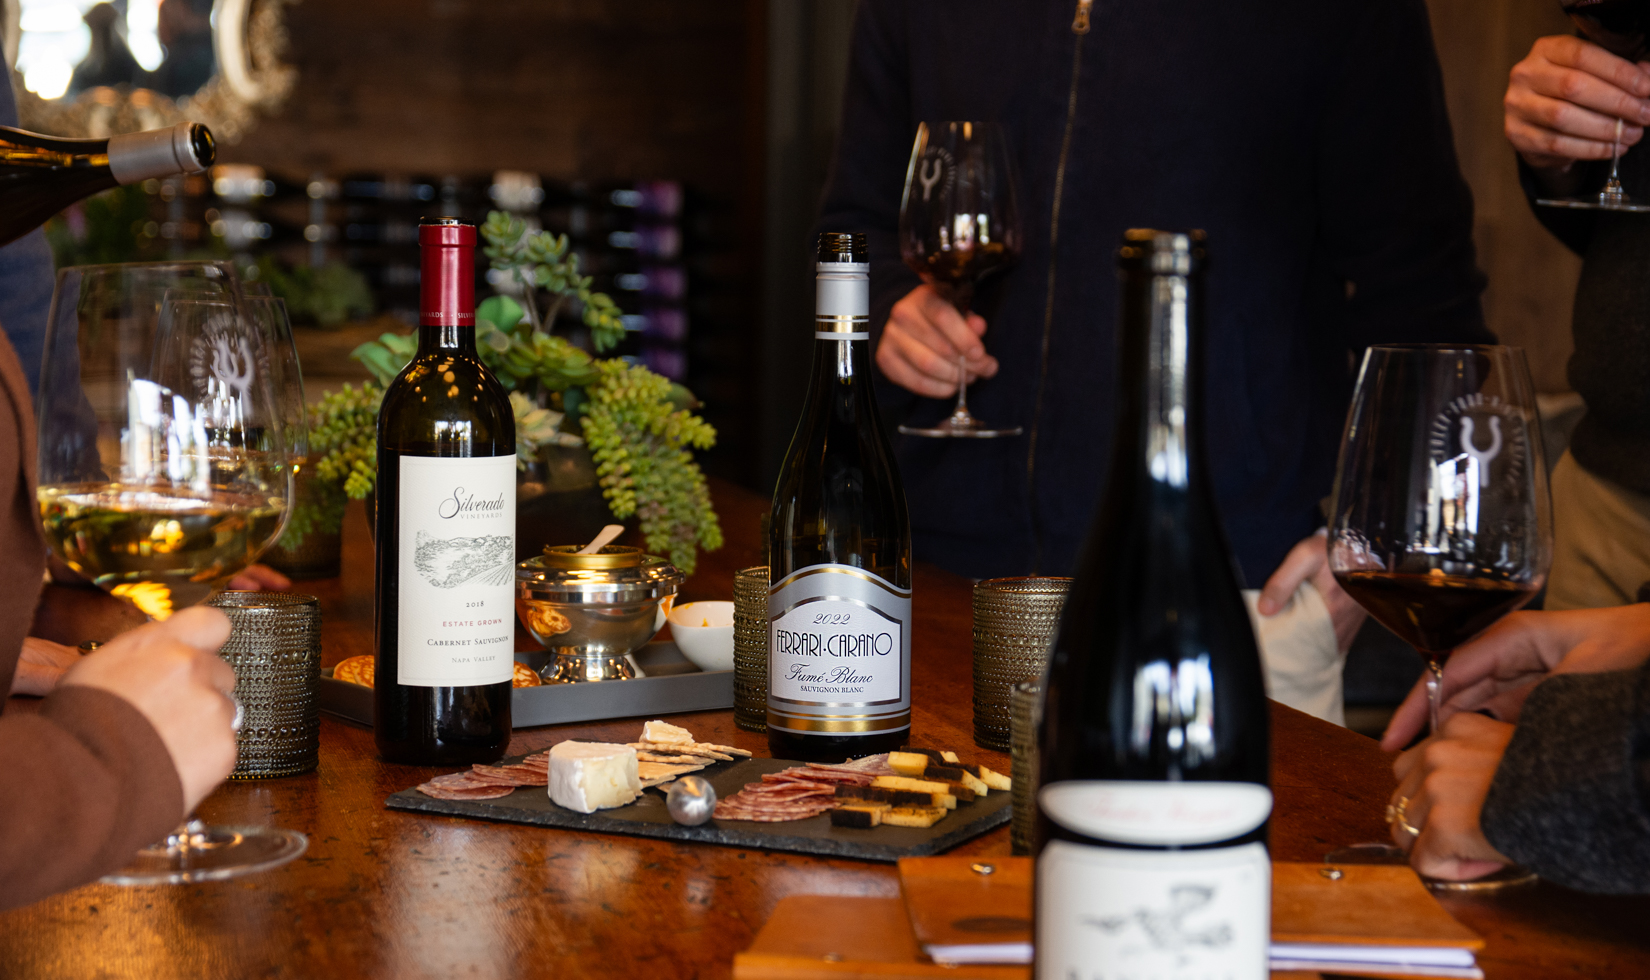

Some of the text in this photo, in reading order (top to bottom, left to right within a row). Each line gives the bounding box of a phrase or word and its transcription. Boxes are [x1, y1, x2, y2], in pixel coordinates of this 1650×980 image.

[438, 486, 505, 519] Silverado
[466, 600, 485, 608] 2018
[477, 618, 502, 626] GROWN
[813, 613, 851, 625] 2022
[784, 663, 873, 683] Fumé Blanc
[800, 685, 840, 693] SAUVIGNON
